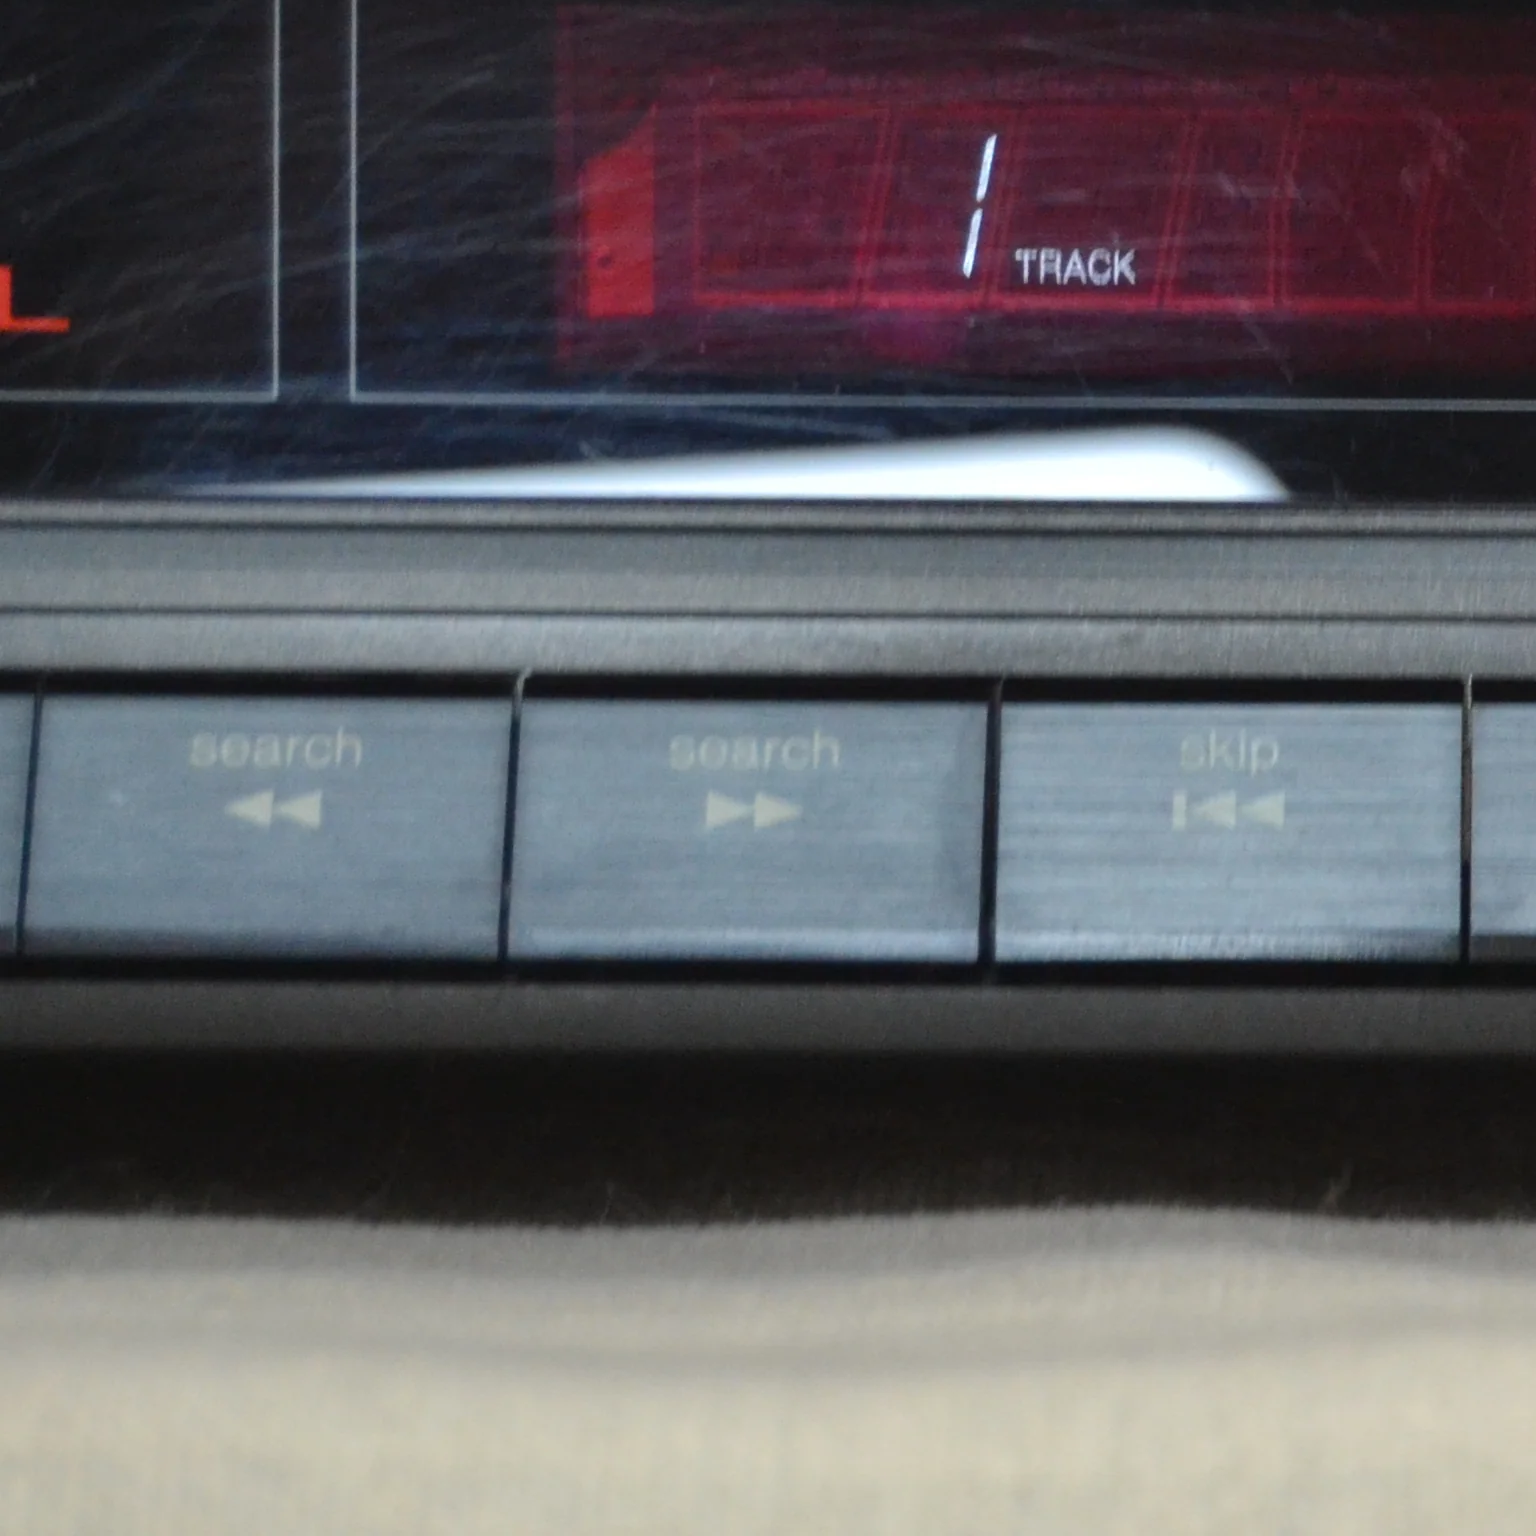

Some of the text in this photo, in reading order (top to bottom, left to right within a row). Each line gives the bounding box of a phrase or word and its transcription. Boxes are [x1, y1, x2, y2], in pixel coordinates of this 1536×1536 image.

[1014, 248, 1137, 287] TRACK
[189, 726, 364, 770] search
[668, 727, 841, 773] search
[1180, 728, 1281, 776] skip
